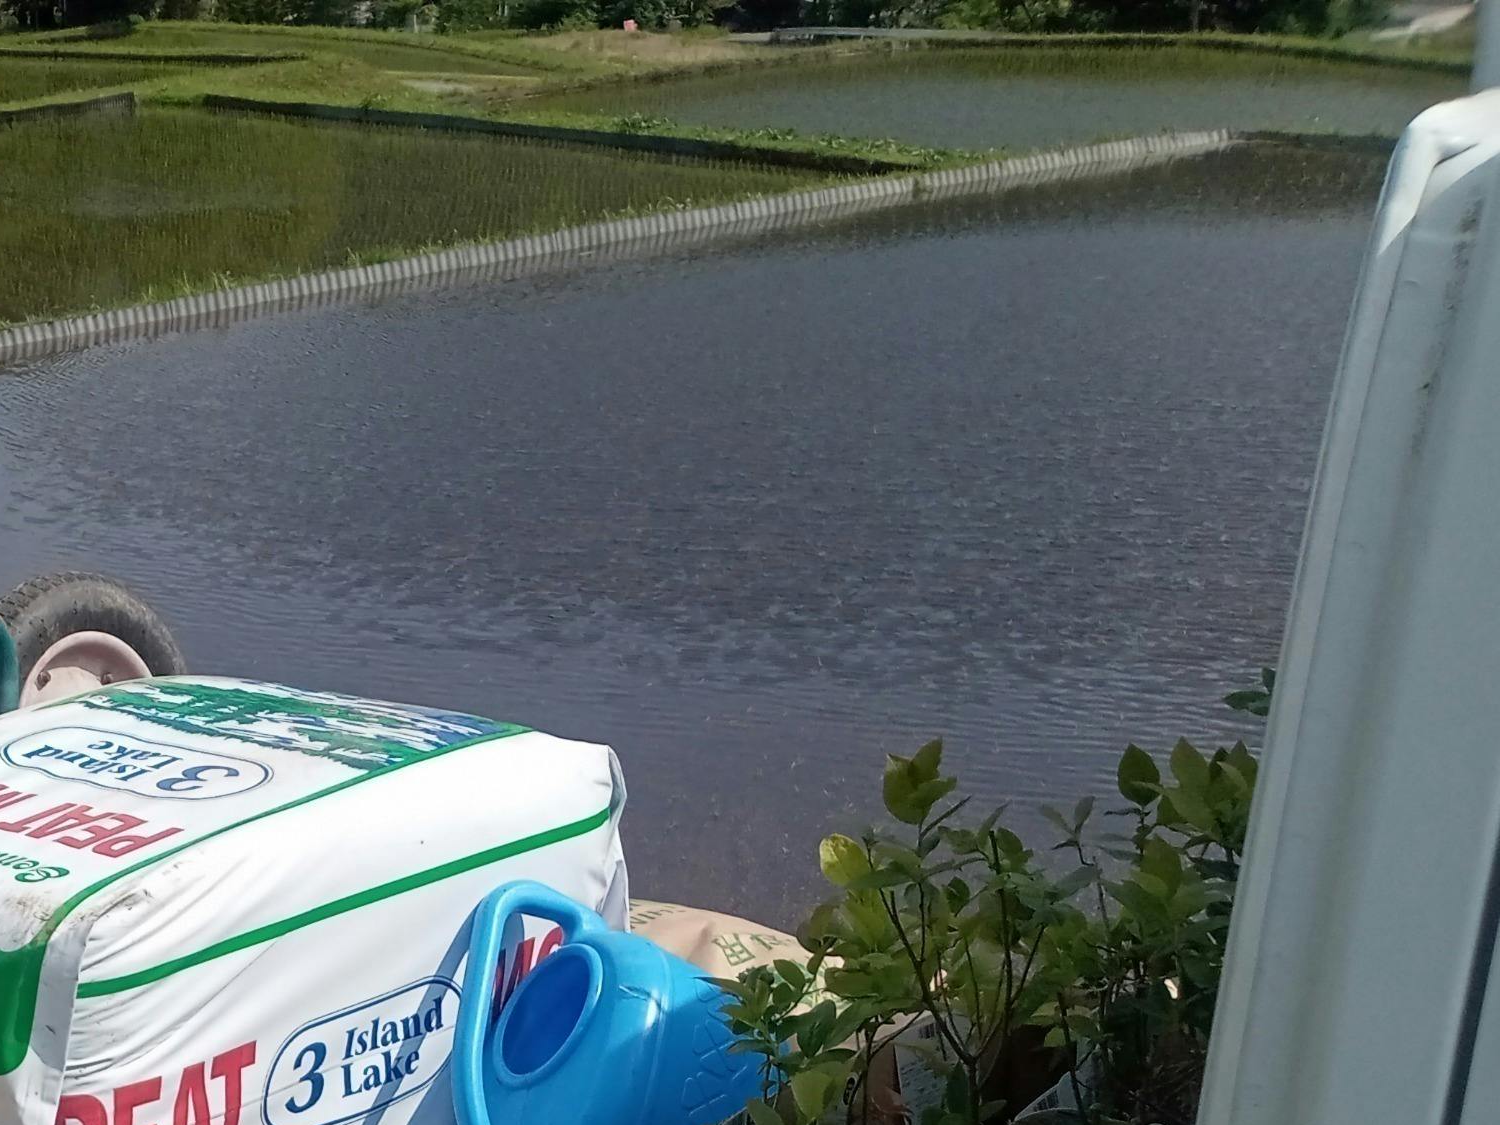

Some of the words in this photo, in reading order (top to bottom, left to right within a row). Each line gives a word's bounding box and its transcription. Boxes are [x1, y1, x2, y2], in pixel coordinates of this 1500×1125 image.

[24, 744, 152, 782] Island
[88, 739, 183, 769] Lake
[156, 765, 239, 792] 3
[285, 1041, 327, 1114] 3
[344, 996, 444, 1061] Island
[341, 1045, 420, 1098] Lake
